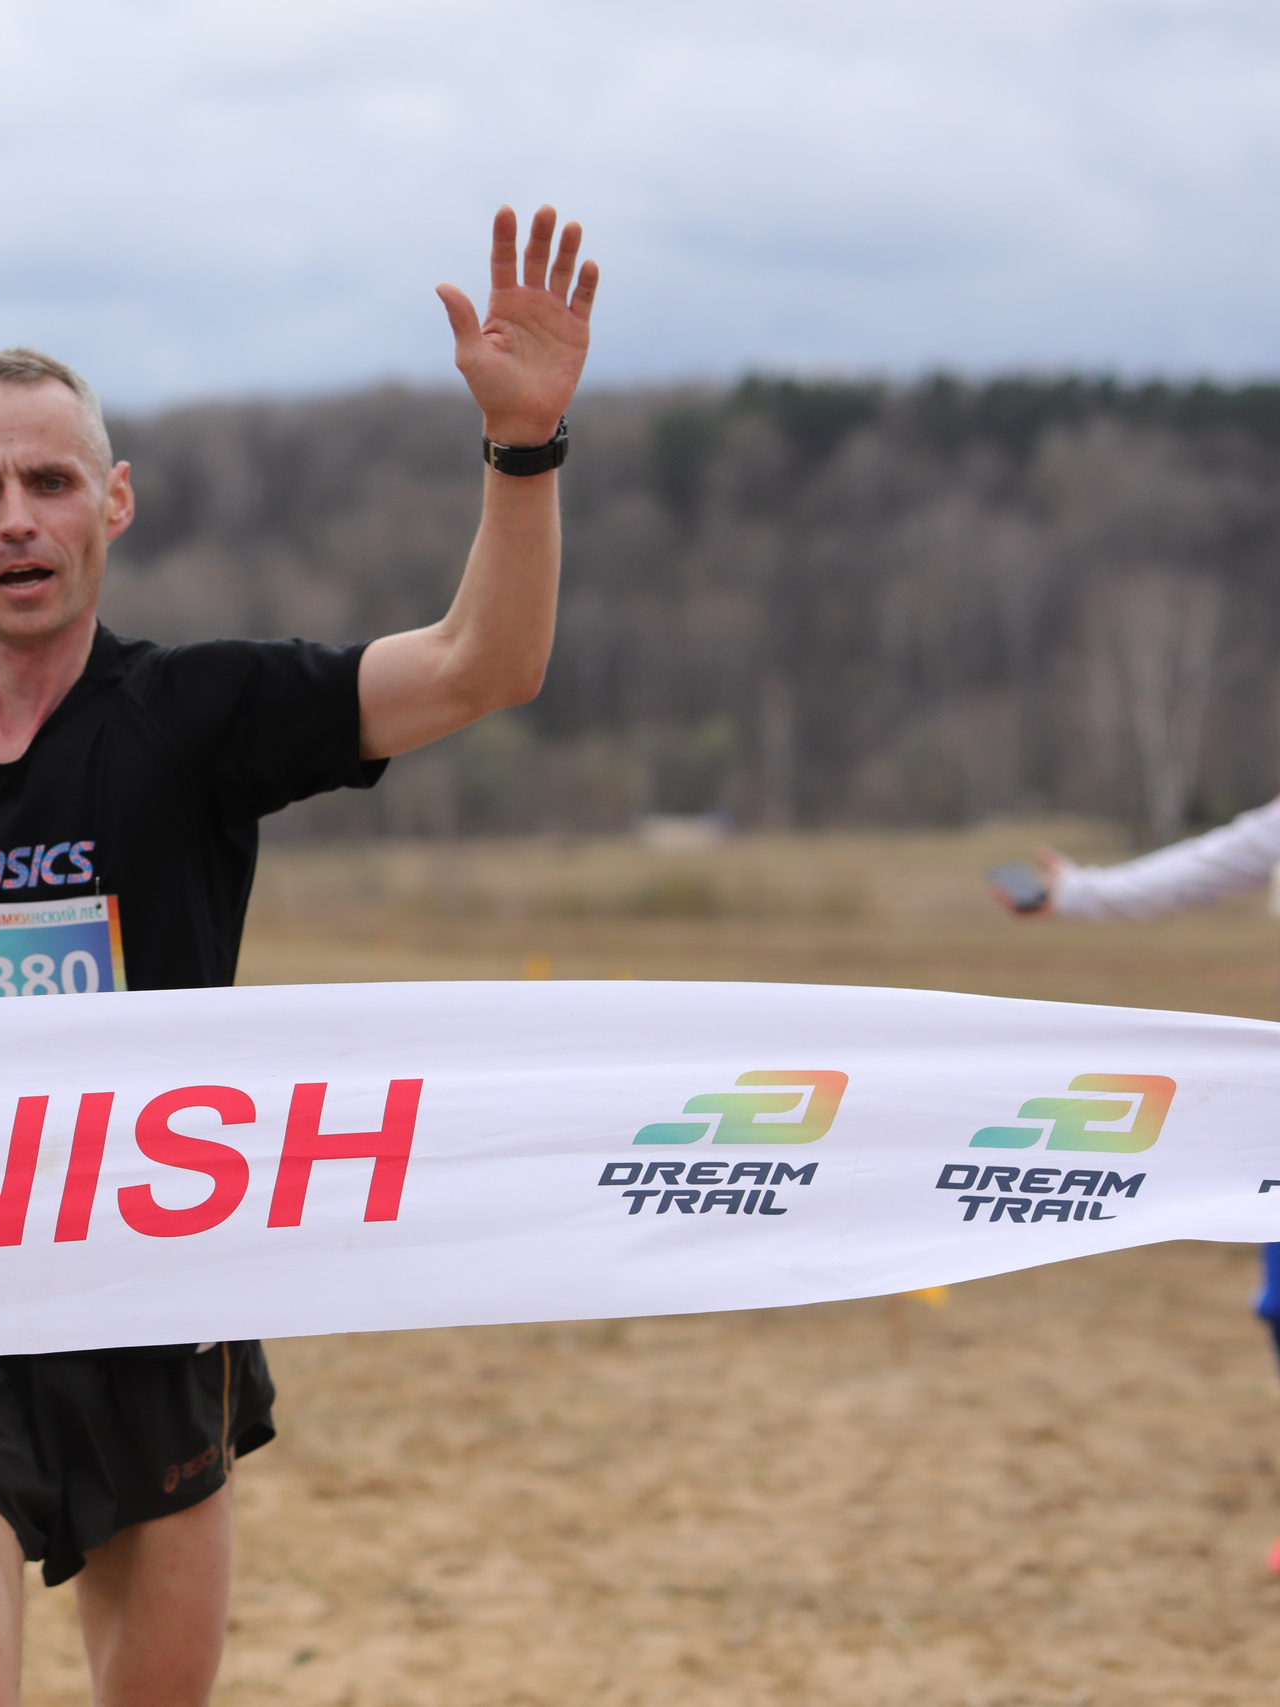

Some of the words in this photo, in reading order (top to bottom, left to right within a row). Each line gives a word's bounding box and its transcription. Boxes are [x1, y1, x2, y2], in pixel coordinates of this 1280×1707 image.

[80, 905, 104, 920] ЛЕС
[598, 1161, 819, 1186] DREAM
[935, 1163, 1147, 1199] DREAM
[621, 1189, 788, 1215] TRAIL
[957, 1195, 1117, 1223] TRAIL
